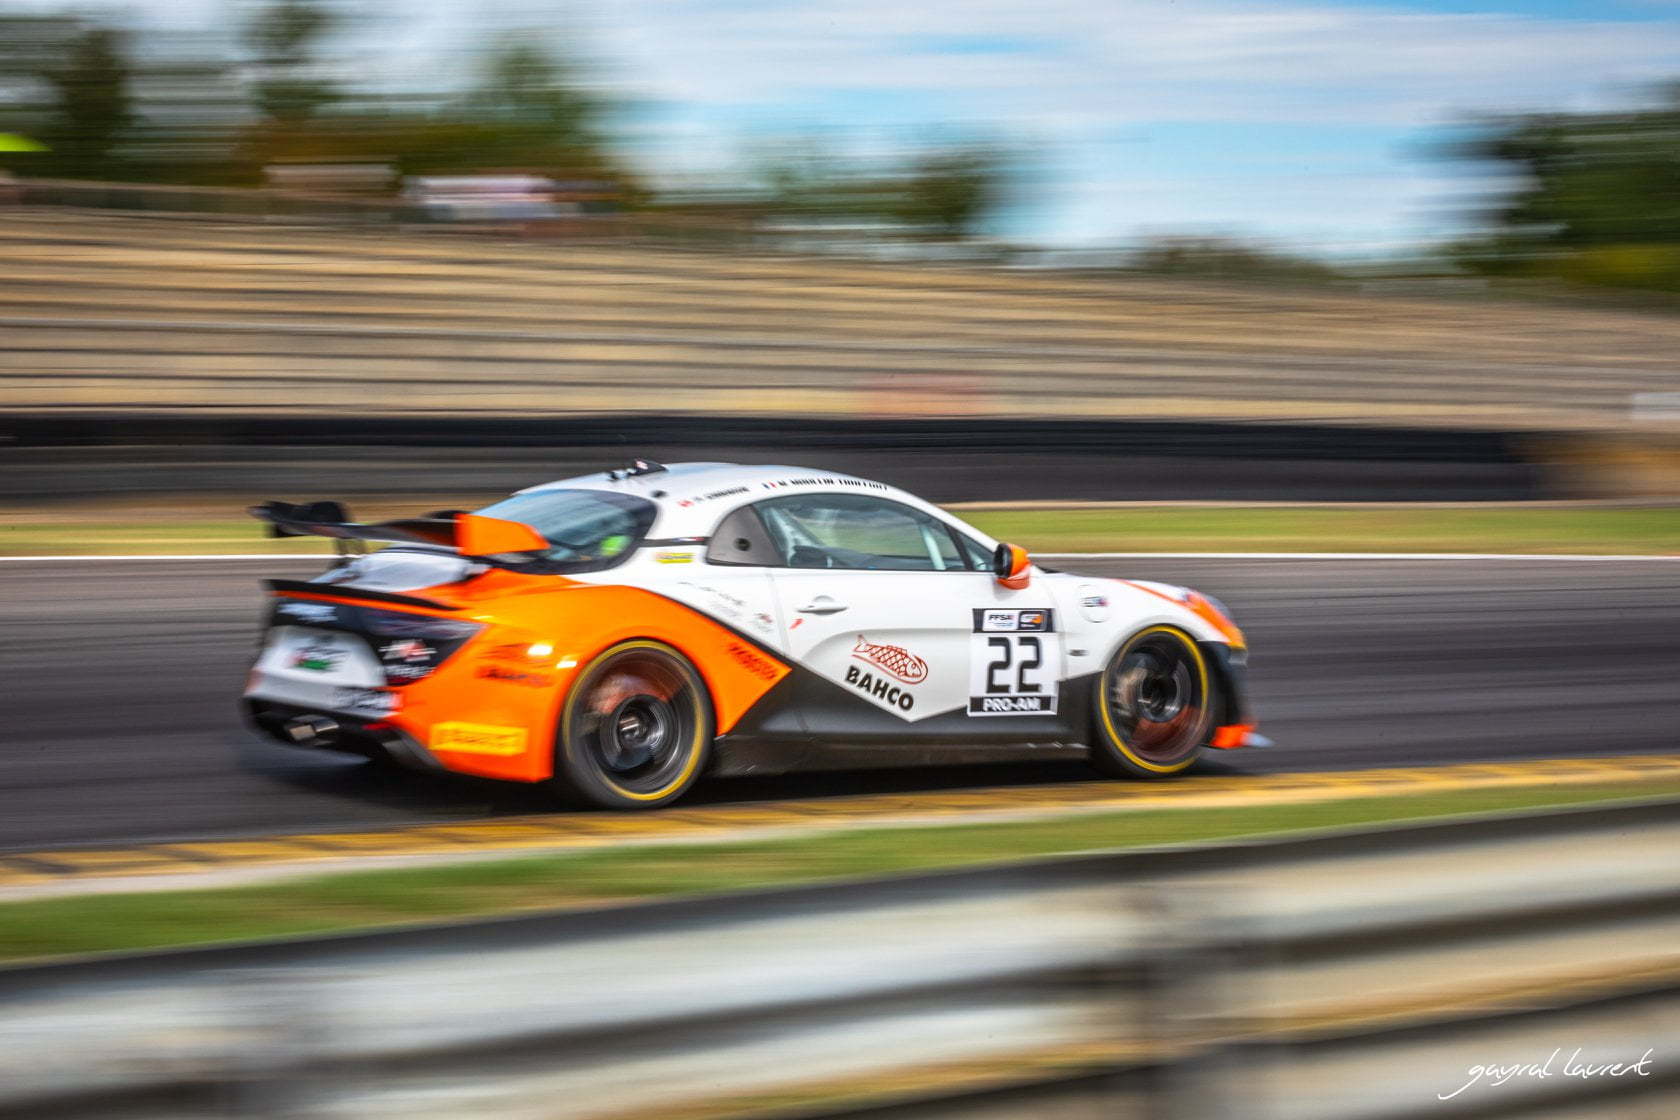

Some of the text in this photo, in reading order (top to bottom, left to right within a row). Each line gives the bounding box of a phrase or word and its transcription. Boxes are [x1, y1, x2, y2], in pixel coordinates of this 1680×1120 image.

[845, 665, 914, 711] BAHCO
[986, 636, 1043, 694] 22
[983, 697, 1041, 712] PRO-AM
